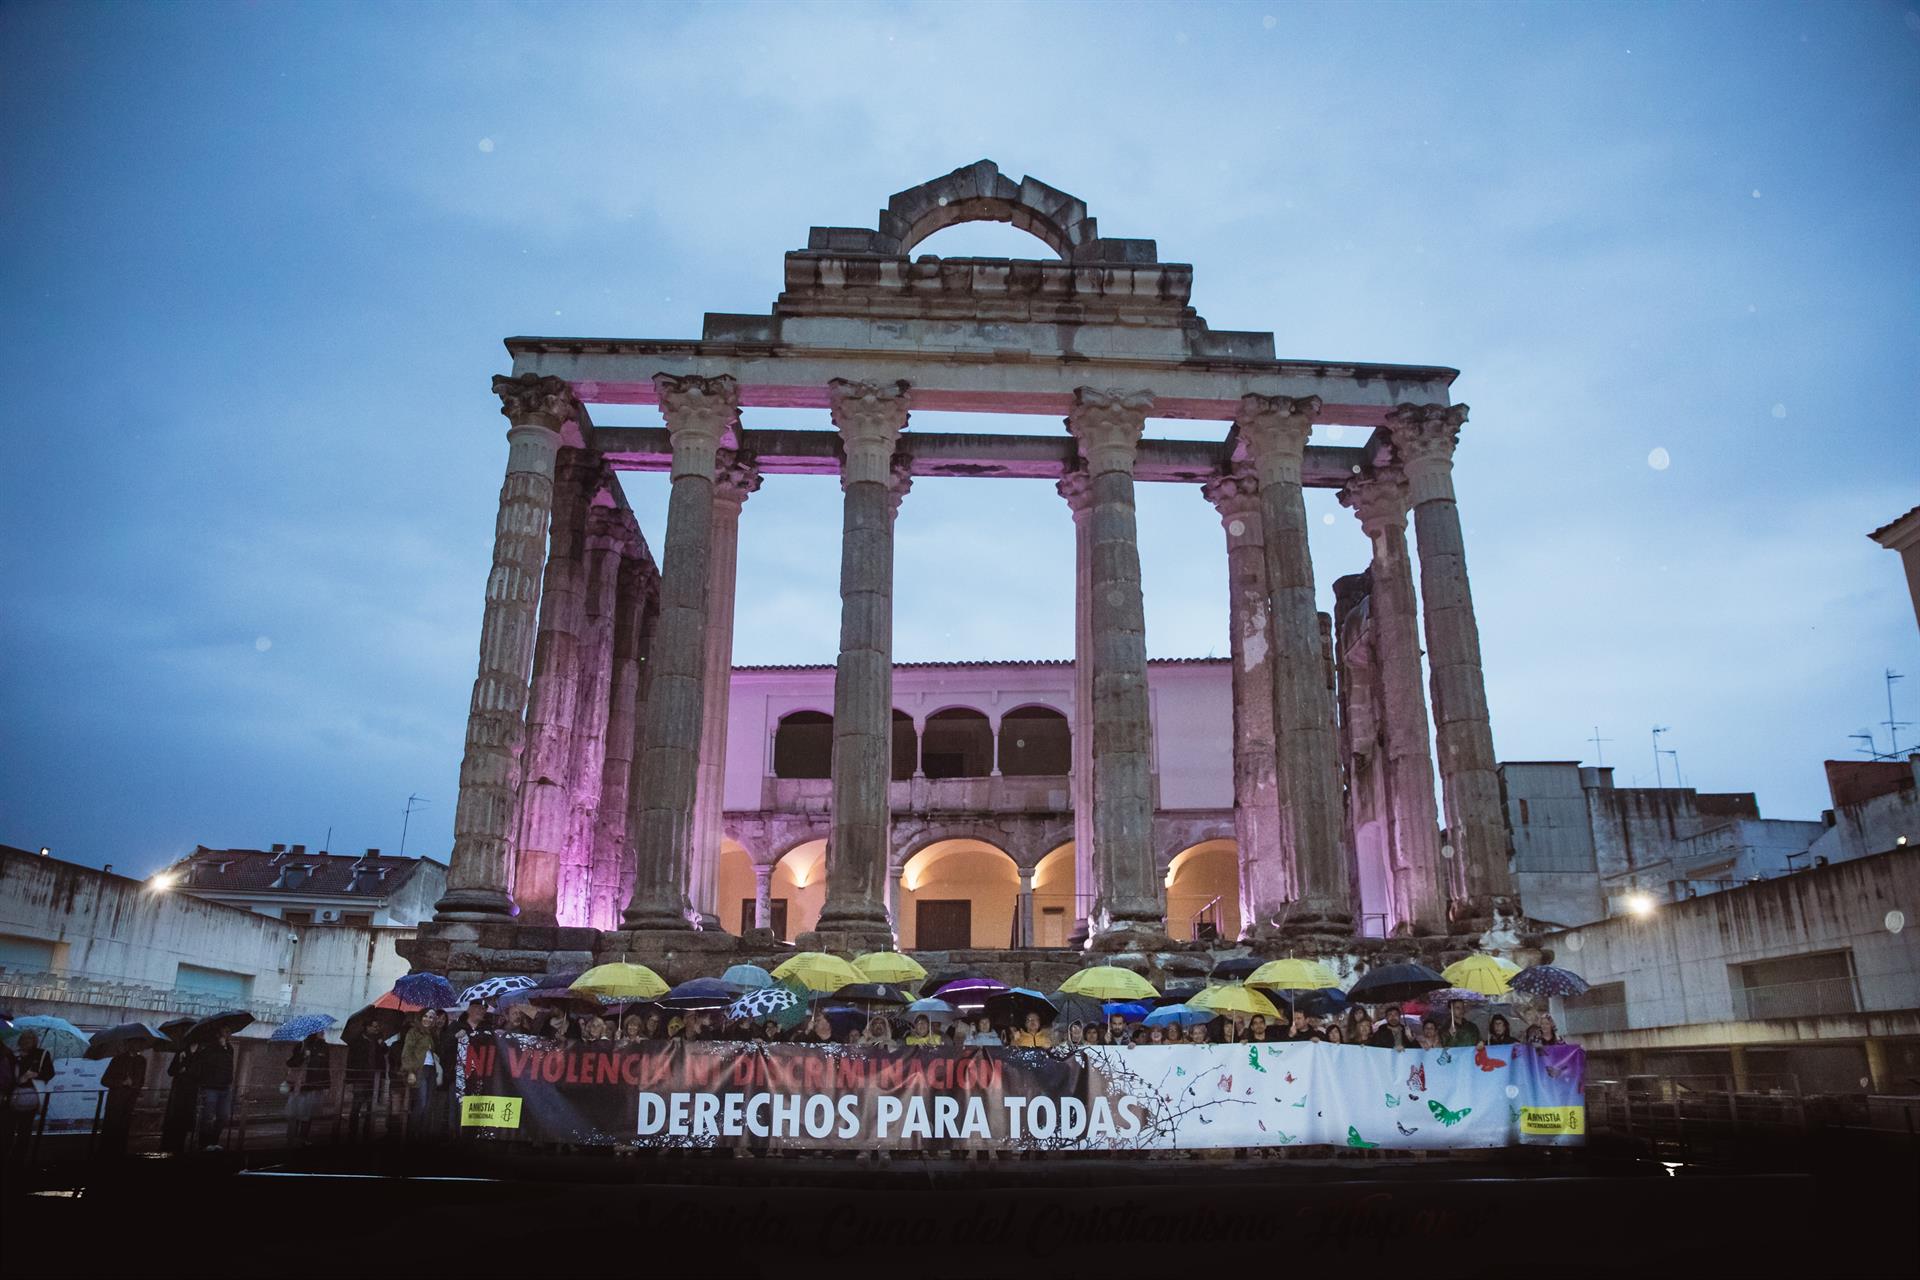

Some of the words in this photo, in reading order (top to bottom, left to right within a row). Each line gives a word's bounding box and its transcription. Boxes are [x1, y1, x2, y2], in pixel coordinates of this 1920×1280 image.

[465, 1044, 496, 1078] NI
[508, 1047, 672, 1088] VIOLENCIA
[637, 1092, 860, 1139] DERECHOS
[877, 1094, 992, 1139] PARA
[1004, 1095, 1142, 1140] TODAS
